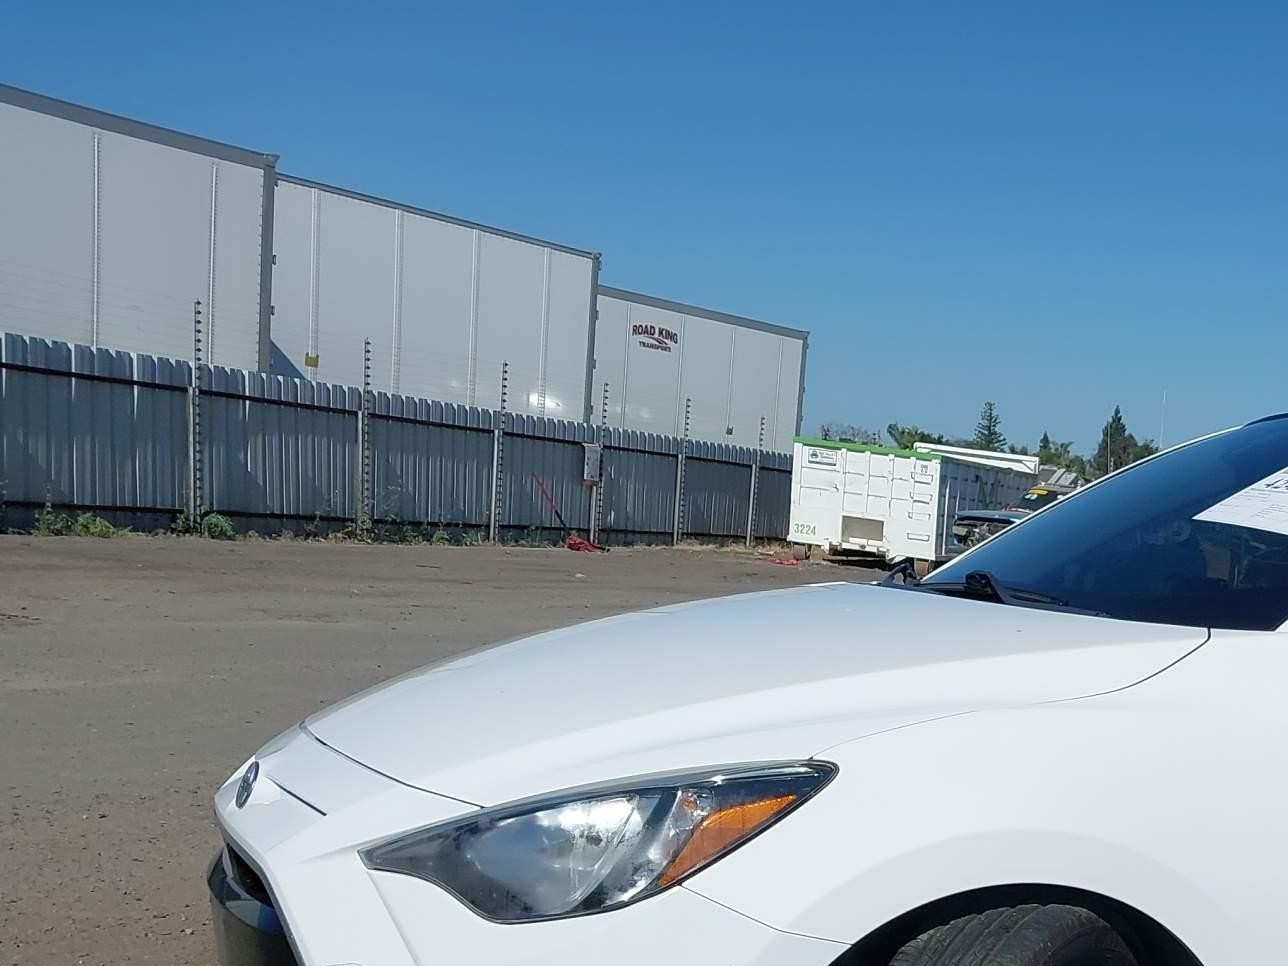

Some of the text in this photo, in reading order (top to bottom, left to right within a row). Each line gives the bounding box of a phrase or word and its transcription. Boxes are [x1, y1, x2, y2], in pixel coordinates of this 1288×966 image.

[632, 324, 678, 344] ROAD KING
[794, 523, 816, 536] 3224
